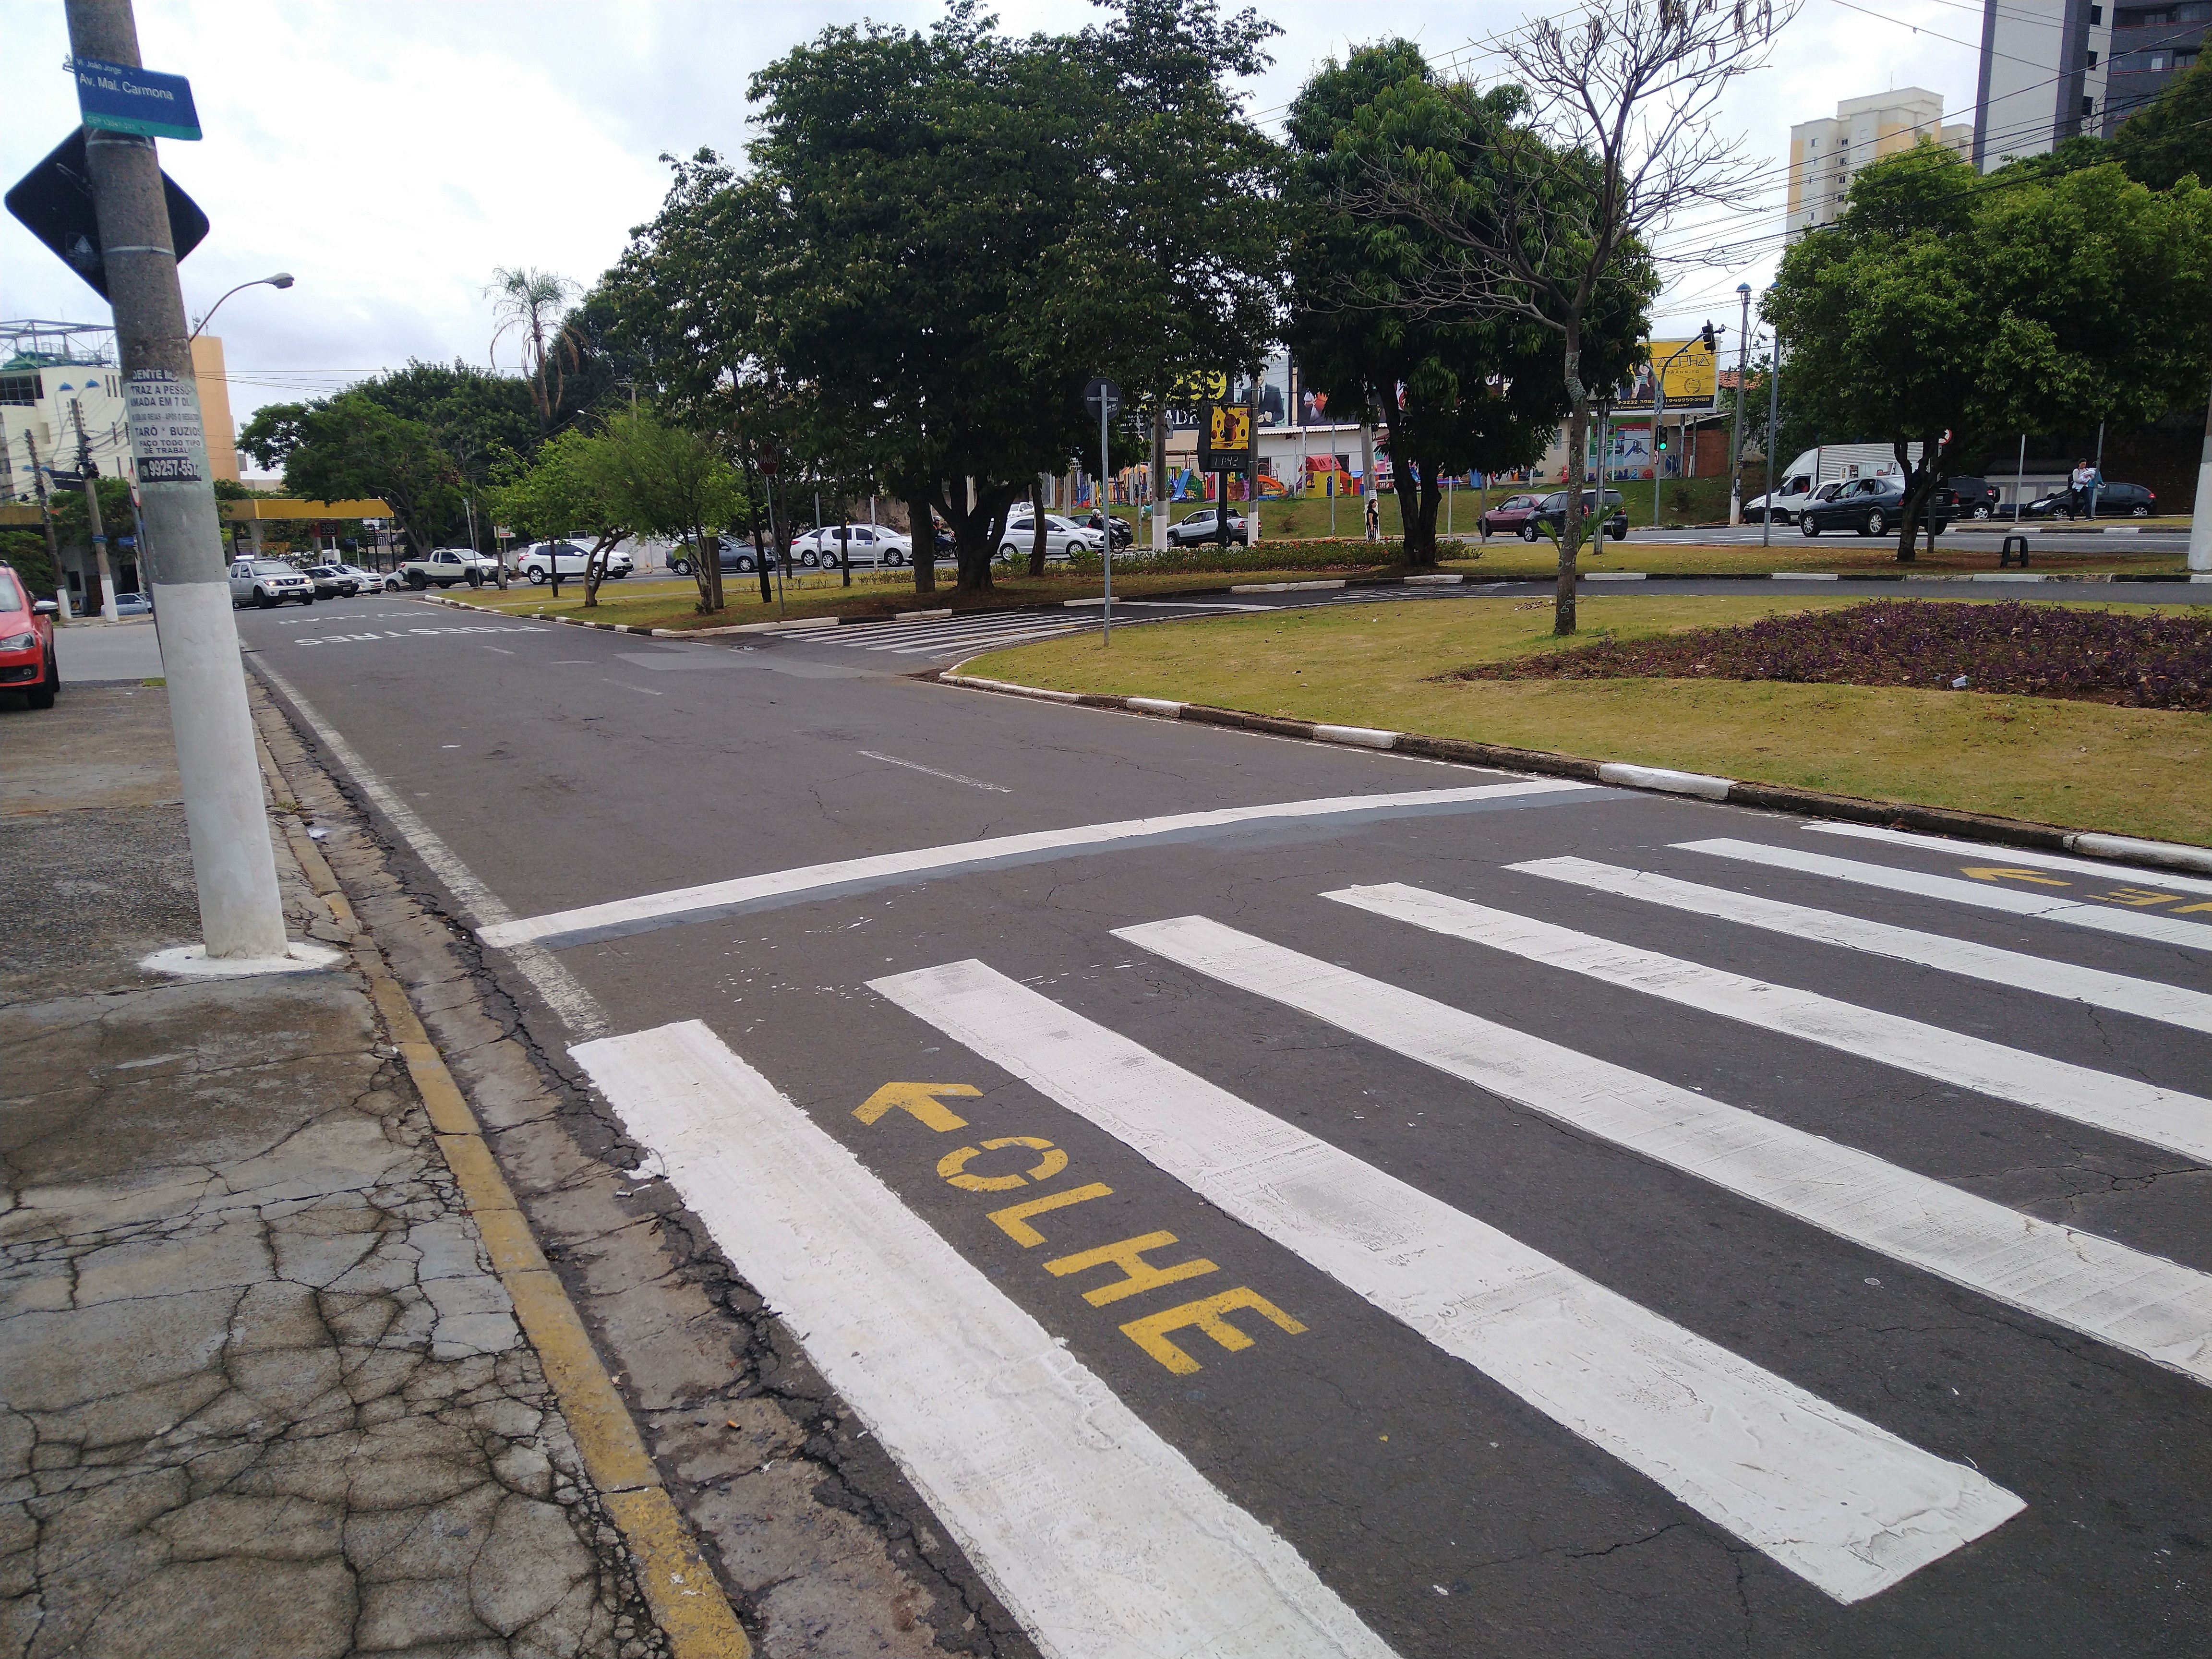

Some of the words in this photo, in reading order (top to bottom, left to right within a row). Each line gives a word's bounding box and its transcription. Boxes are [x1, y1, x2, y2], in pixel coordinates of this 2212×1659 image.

[79, 72, 95, 86] Av.
[97, 76, 120, 92] Mal.
[122, 81, 174, 101] Carmona
[1657, 355, 1710, 367] ALPHA
[131, 385, 152, 395] TRAZ
[155, 385, 162, 395] A
[159, 397, 172, 407] EM
[174, 397, 180, 406] 7
[1215, 456, 1238, 466] 11:42
[936, 1136, 1310, 1377] OLHE
